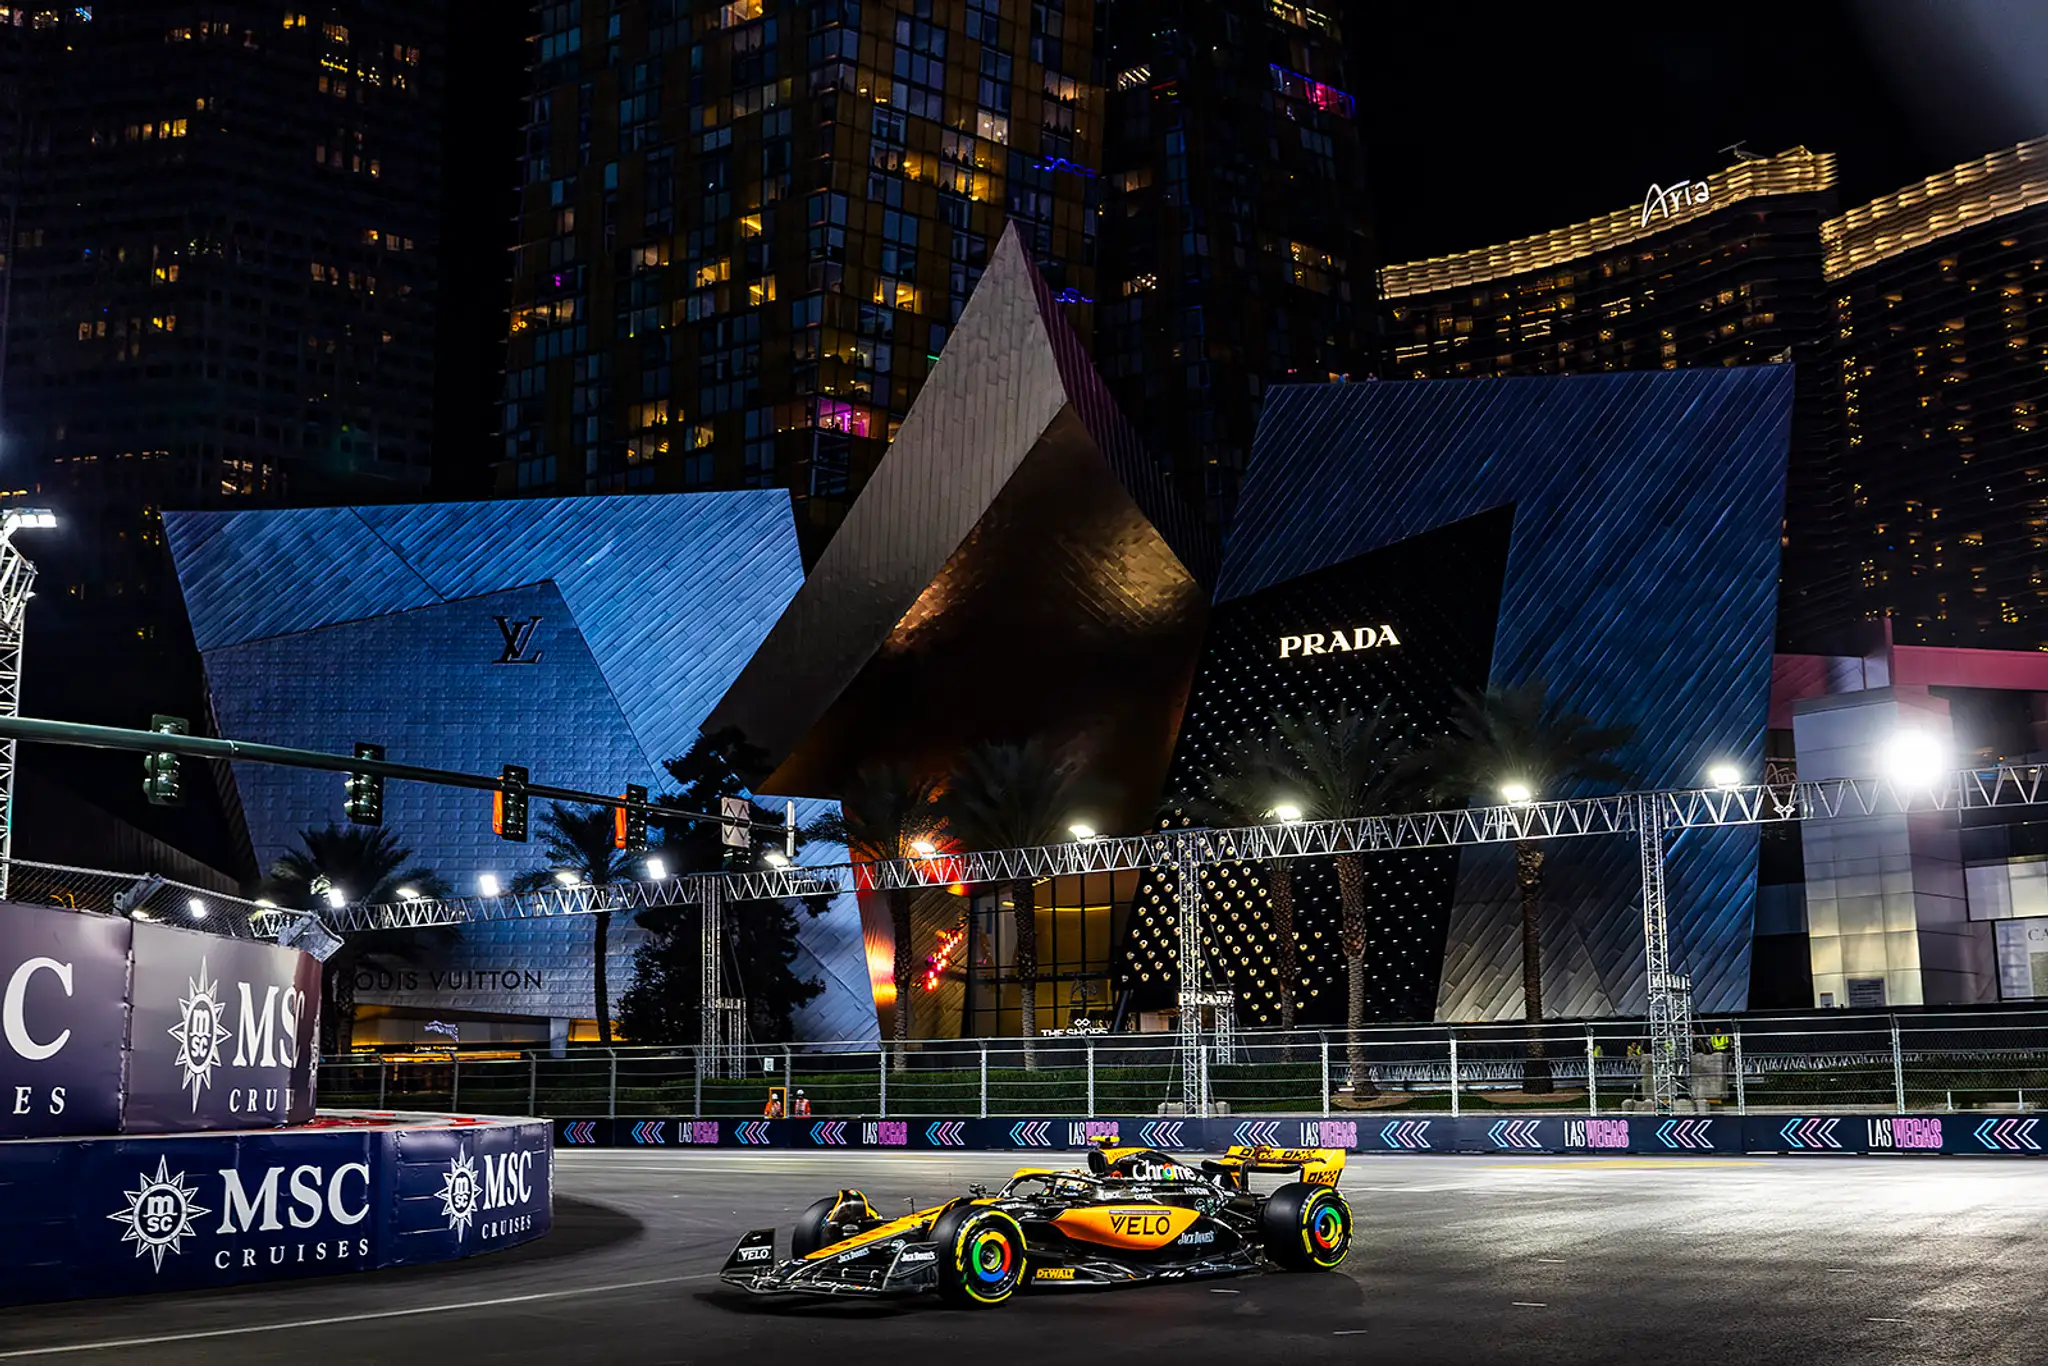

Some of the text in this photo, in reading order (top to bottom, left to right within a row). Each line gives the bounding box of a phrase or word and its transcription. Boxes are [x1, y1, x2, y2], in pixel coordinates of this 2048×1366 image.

[1641, 180, 1709, 227] Aria
[1279, 625, 1401, 658] PRADA
[354, 970, 542, 991] OUIS VUITTON
[1041, 1027, 1108, 1037] THE SHOPS
[679, 1122, 692, 1143] LAS
[863, 1122, 877, 1144] LAS
[1069, 1122, 1085, 1145] LAS
[1301, 1122, 1319, 1147] LAS
[1564, 1120, 1629, 1148] LAS VEGAS
[1868, 1118, 1942, 1148] LAS VEGAS
[483, 1150, 532, 1210] MSC
[1133, 1159, 1197, 1181] Chrome
[216, 1163, 370, 1234] MSC
[481, 1215, 532, 1239] CRUISES
[1110, 1216, 1170, 1235] VELO
[215, 1239, 369, 1269] CRUISES
[741, 1249, 769, 1260] VELO
[1036, 1268, 1075, 1280] DEWALT
